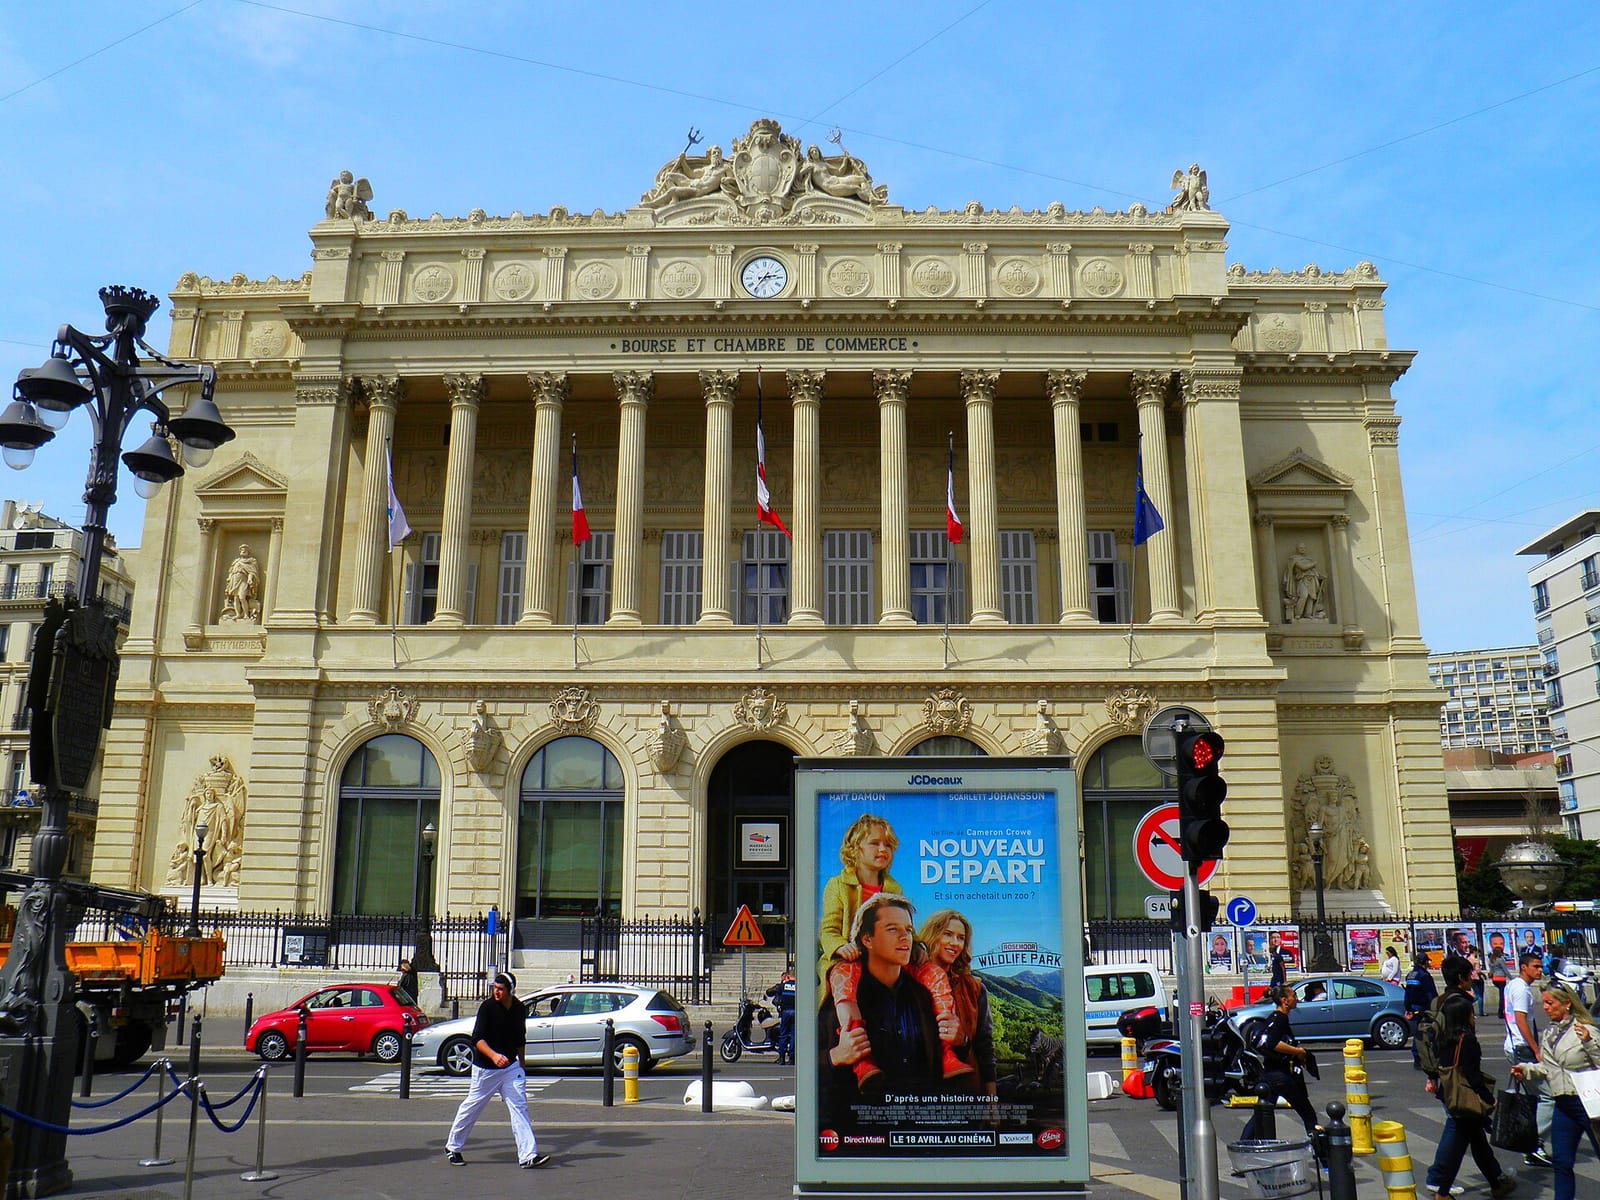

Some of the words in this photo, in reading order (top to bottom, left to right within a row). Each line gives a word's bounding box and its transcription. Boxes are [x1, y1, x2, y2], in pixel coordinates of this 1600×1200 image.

[621, 339, 676, 353] BOURSE
[687, 339, 706, 353] ET
[713, 338, 786, 352] CHAMBRE
[796, 338, 815, 351] DE
[825, 337, 907, 351] COMMERCE
[908, 775, 963, 786] JCDecaux
[829, 793, 850, 801] MATT
[851, 793, 886, 801] DAMON
[949, 793, 987, 801] SCARLETT
[988, 793, 1045, 801] JOHANSSON
[966, 828, 1003, 836] Cameron
[1006, 828, 1032, 836] Crowe
[919, 839, 1044, 857] NOUVEAU
[920, 859, 1046, 884] DEPART
[934, 891, 943, 900] Et
[946, 891, 953, 900] si
[966, 891, 1000, 900] achetait
[1151, 902, 1172, 912] SAU
[978, 953, 1027, 967] WILDLIFE
[1030, 953, 1062, 967] PARK
[885, 1094, 919, 1104] D'après
[922, 1095, 938, 1103] une
[940, 1093, 974, 1103] histoire
[976, 1093, 999, 1103] vraie
[844, 1136, 865, 1144] Direct
[865, 1136, 885, 1144] Matin
[893, 1135, 904, 1144] LE
[905, 1135, 916, 1144] 18
[917, 1135, 943, 1144] AVRIL
[944, 1135, 957, 1144] AU
[958, 1133, 992, 1144] CINÉMA
